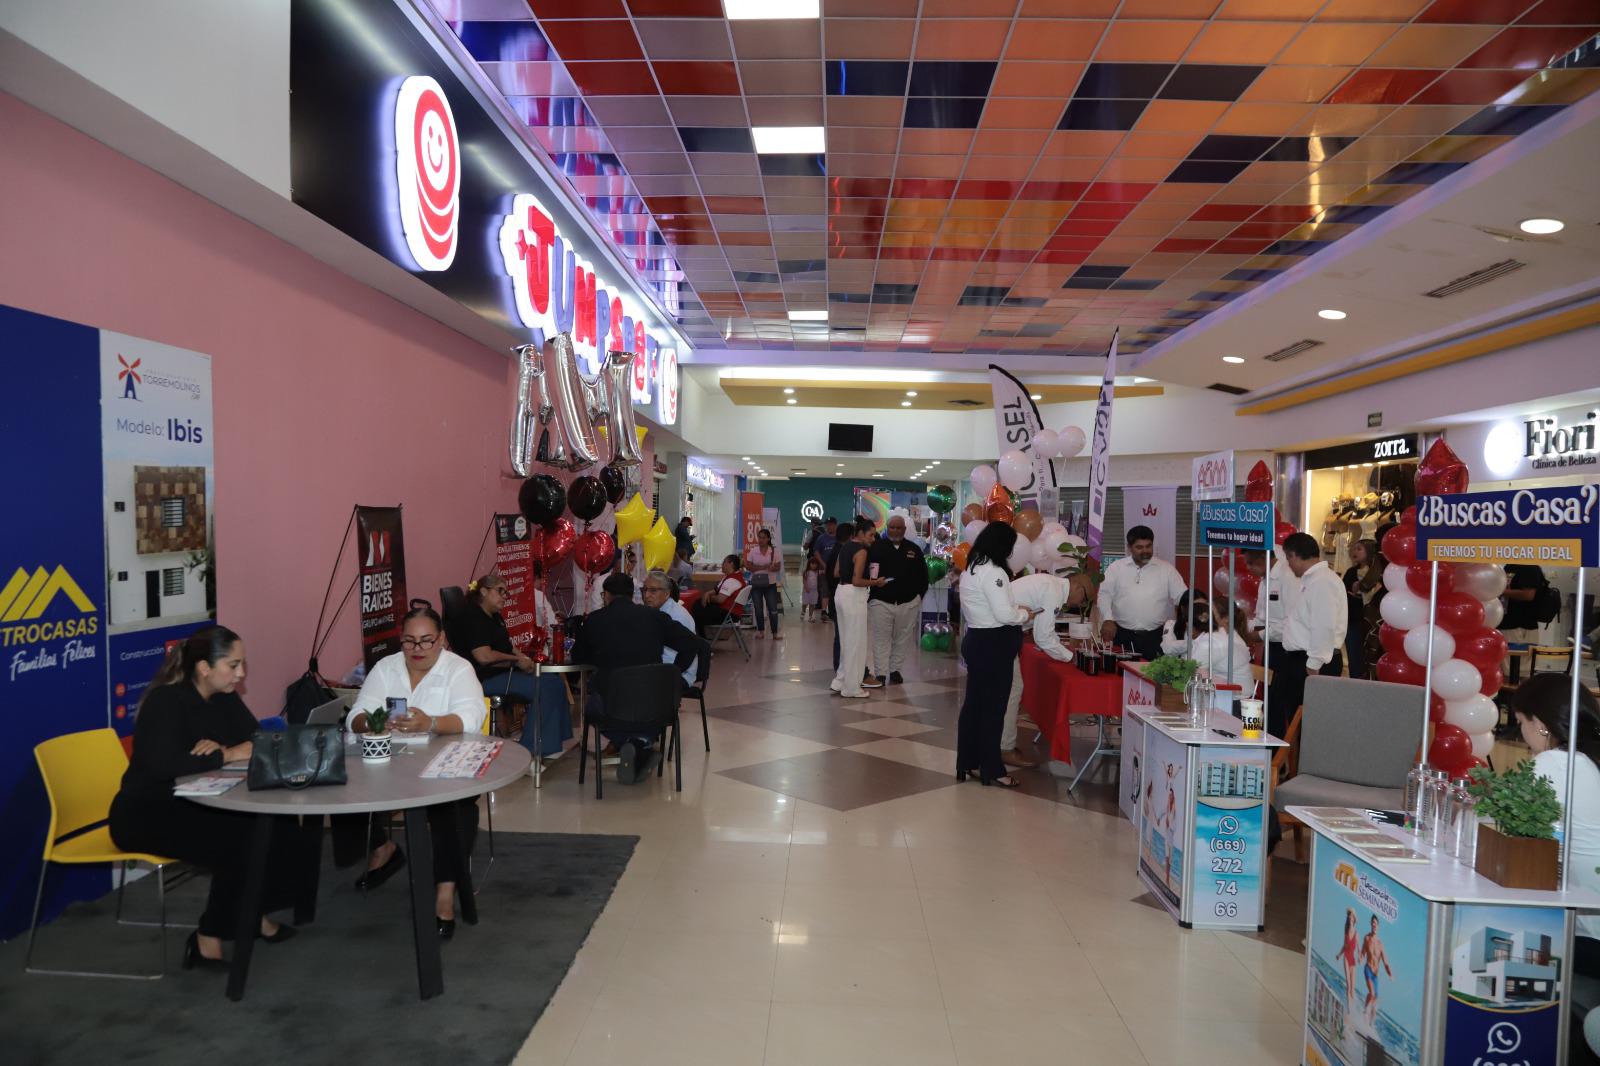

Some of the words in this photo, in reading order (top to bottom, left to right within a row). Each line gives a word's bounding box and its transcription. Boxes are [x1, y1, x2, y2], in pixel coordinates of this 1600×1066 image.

[116, 418, 165, 437] Modelo:
[167, 418, 203, 444] Ibis
[1523, 412, 1596, 457] Fiori
[1374, 438, 1410, 458] zorra.
[1557, 456, 1567, 467] de
[1568, 454, 1597, 466] Belleza
[1202, 504, 1236, 522] ¿Buscas
[1239, 504, 1269, 523] Casa?
[1418, 495, 1506, 527] ¿Buscas
[1511, 484, 1598, 526] Casa?
[1207, 530, 1226, 540] Tenemos
[1227, 532, 1233, 541] tu
[1233, 531, 1248, 543] hogar
[1249, 532, 1264, 543] ideal
[1433, 545, 1476, 558] TENEMOS
[1480, 545, 1491, 558] TU
[1496, 546, 1534, 560] HOGAR
[1538, 546, 1573, 560] IDEAL
[363, 571, 393, 594] BIENES
[362, 590, 393, 614] RAICES
[0, 616, 98, 647] TROCASAS
[9, 650, 57, 682] Familias
[62, 640, 96, 670] Felices
[120, 646, 165, 661] Construcción
[1210, 839, 1246, 855] (669)
[1212, 857, 1243, 873] 272
[1216, 880, 1237, 895] 74
[1214, 902, 1237, 917] 66
[1359, 885, 1398, 919] SEMINARIO
